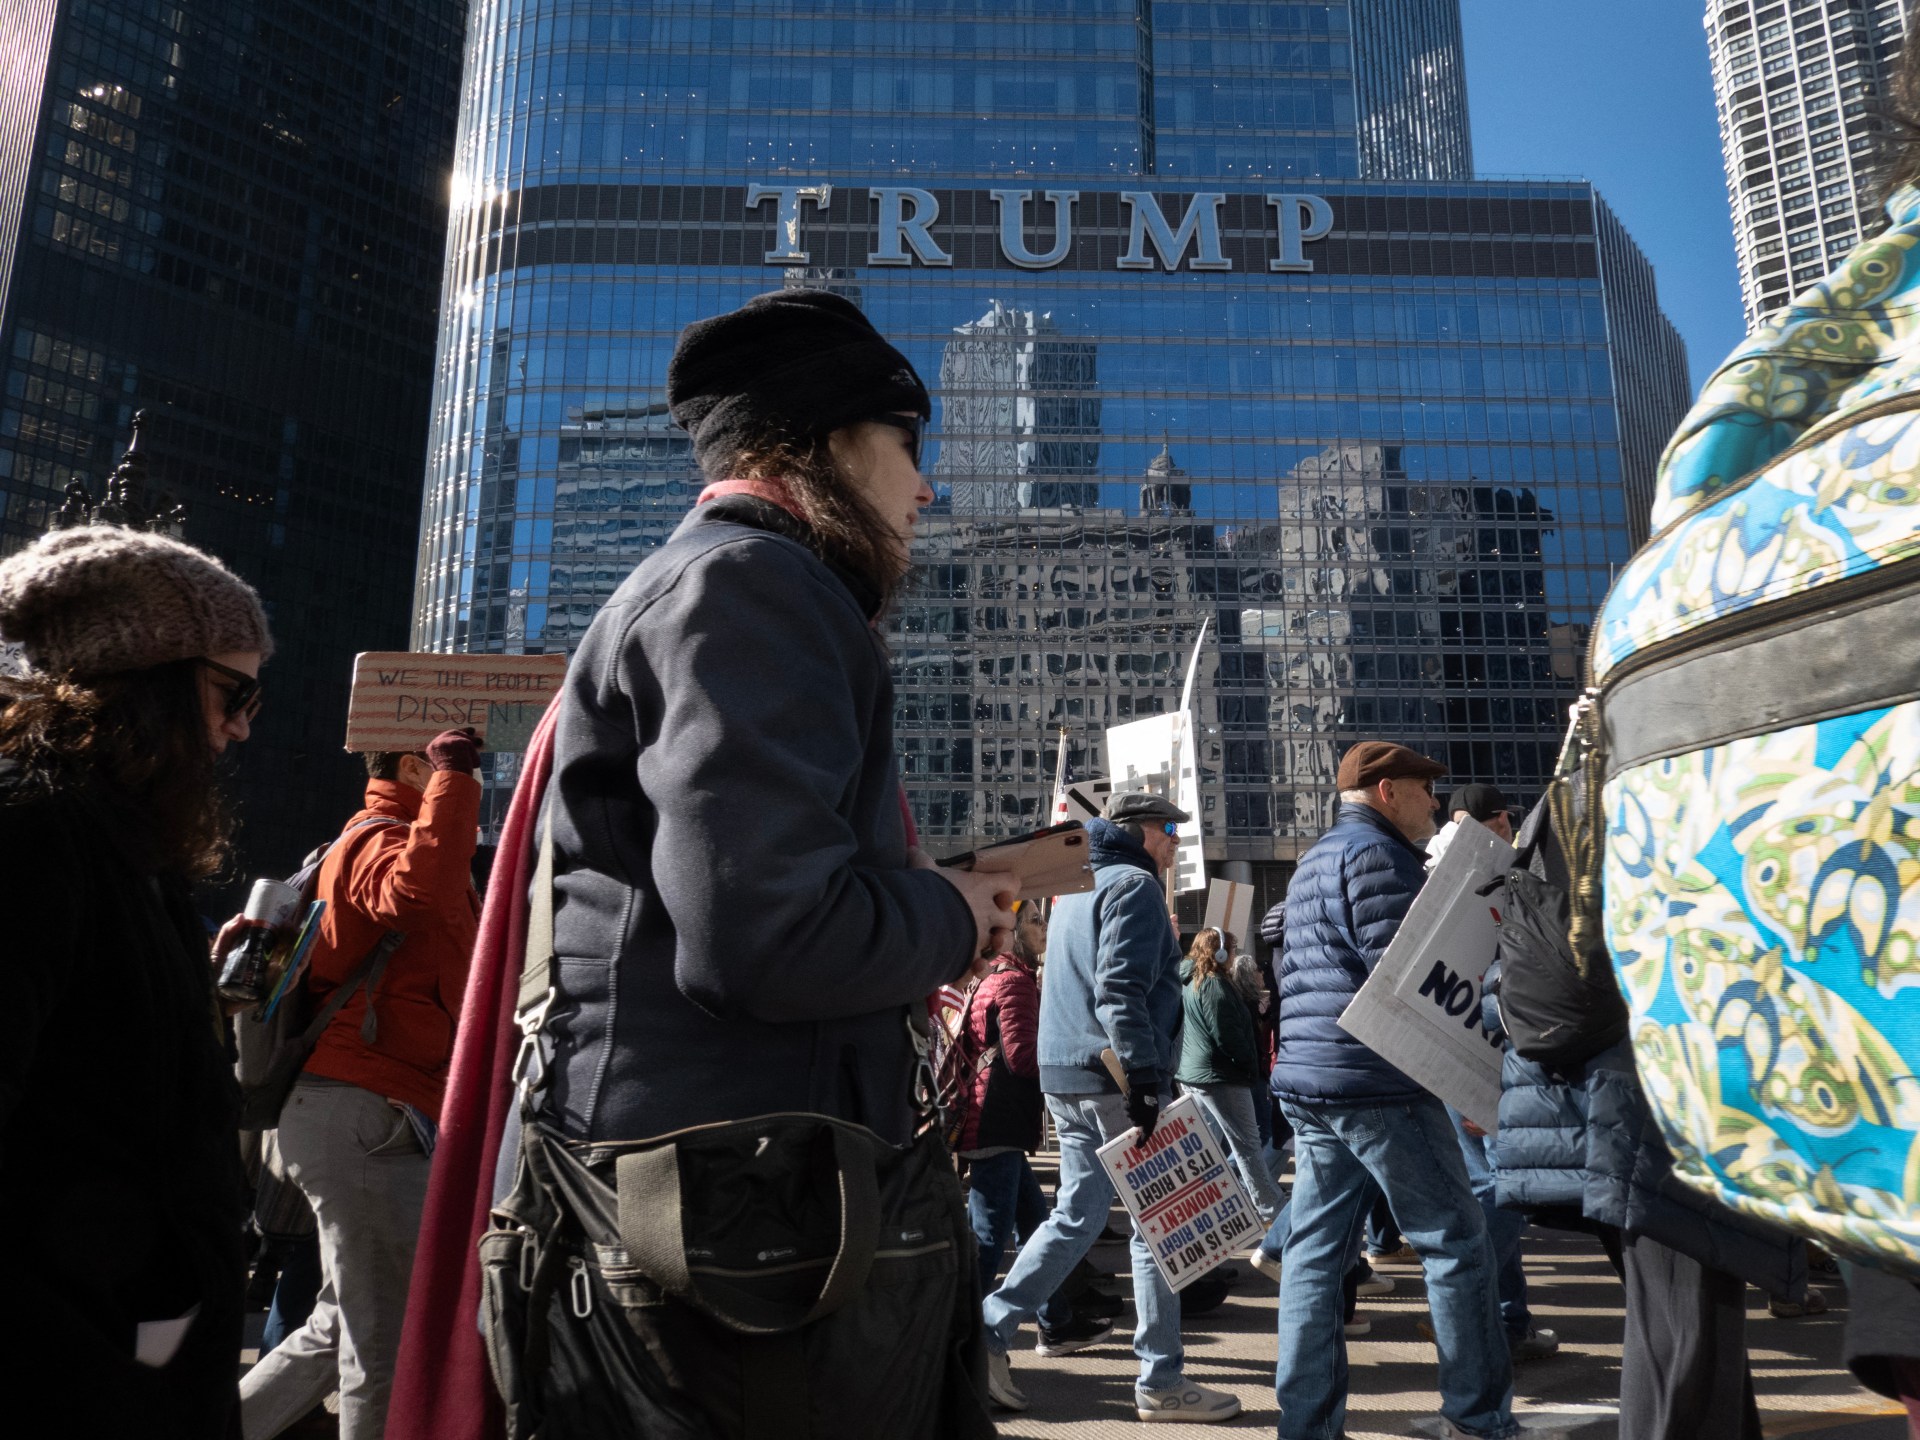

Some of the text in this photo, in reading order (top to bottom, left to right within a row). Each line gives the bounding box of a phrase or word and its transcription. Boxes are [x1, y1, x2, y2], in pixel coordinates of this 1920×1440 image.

[745, 182, 1334, 272] TRUMP
[378, 669, 550, 690] WE THE PEOPLE
[396, 694, 531, 725] DISSENT
[1418, 960, 1474, 1016] NO
[1123, 1117, 1189, 1169] MOMENT
[1125, 1132, 1203, 1191] OR WRONG
[1134, 1149, 1216, 1211] IT'S A RIGHT
[1158, 1181, 1223, 1234] MOMENT
[1156, 1193, 1244, 1260] LEFT OR RIGHT
[1165, 1211, 1253, 1276] THIS IS NOT A
